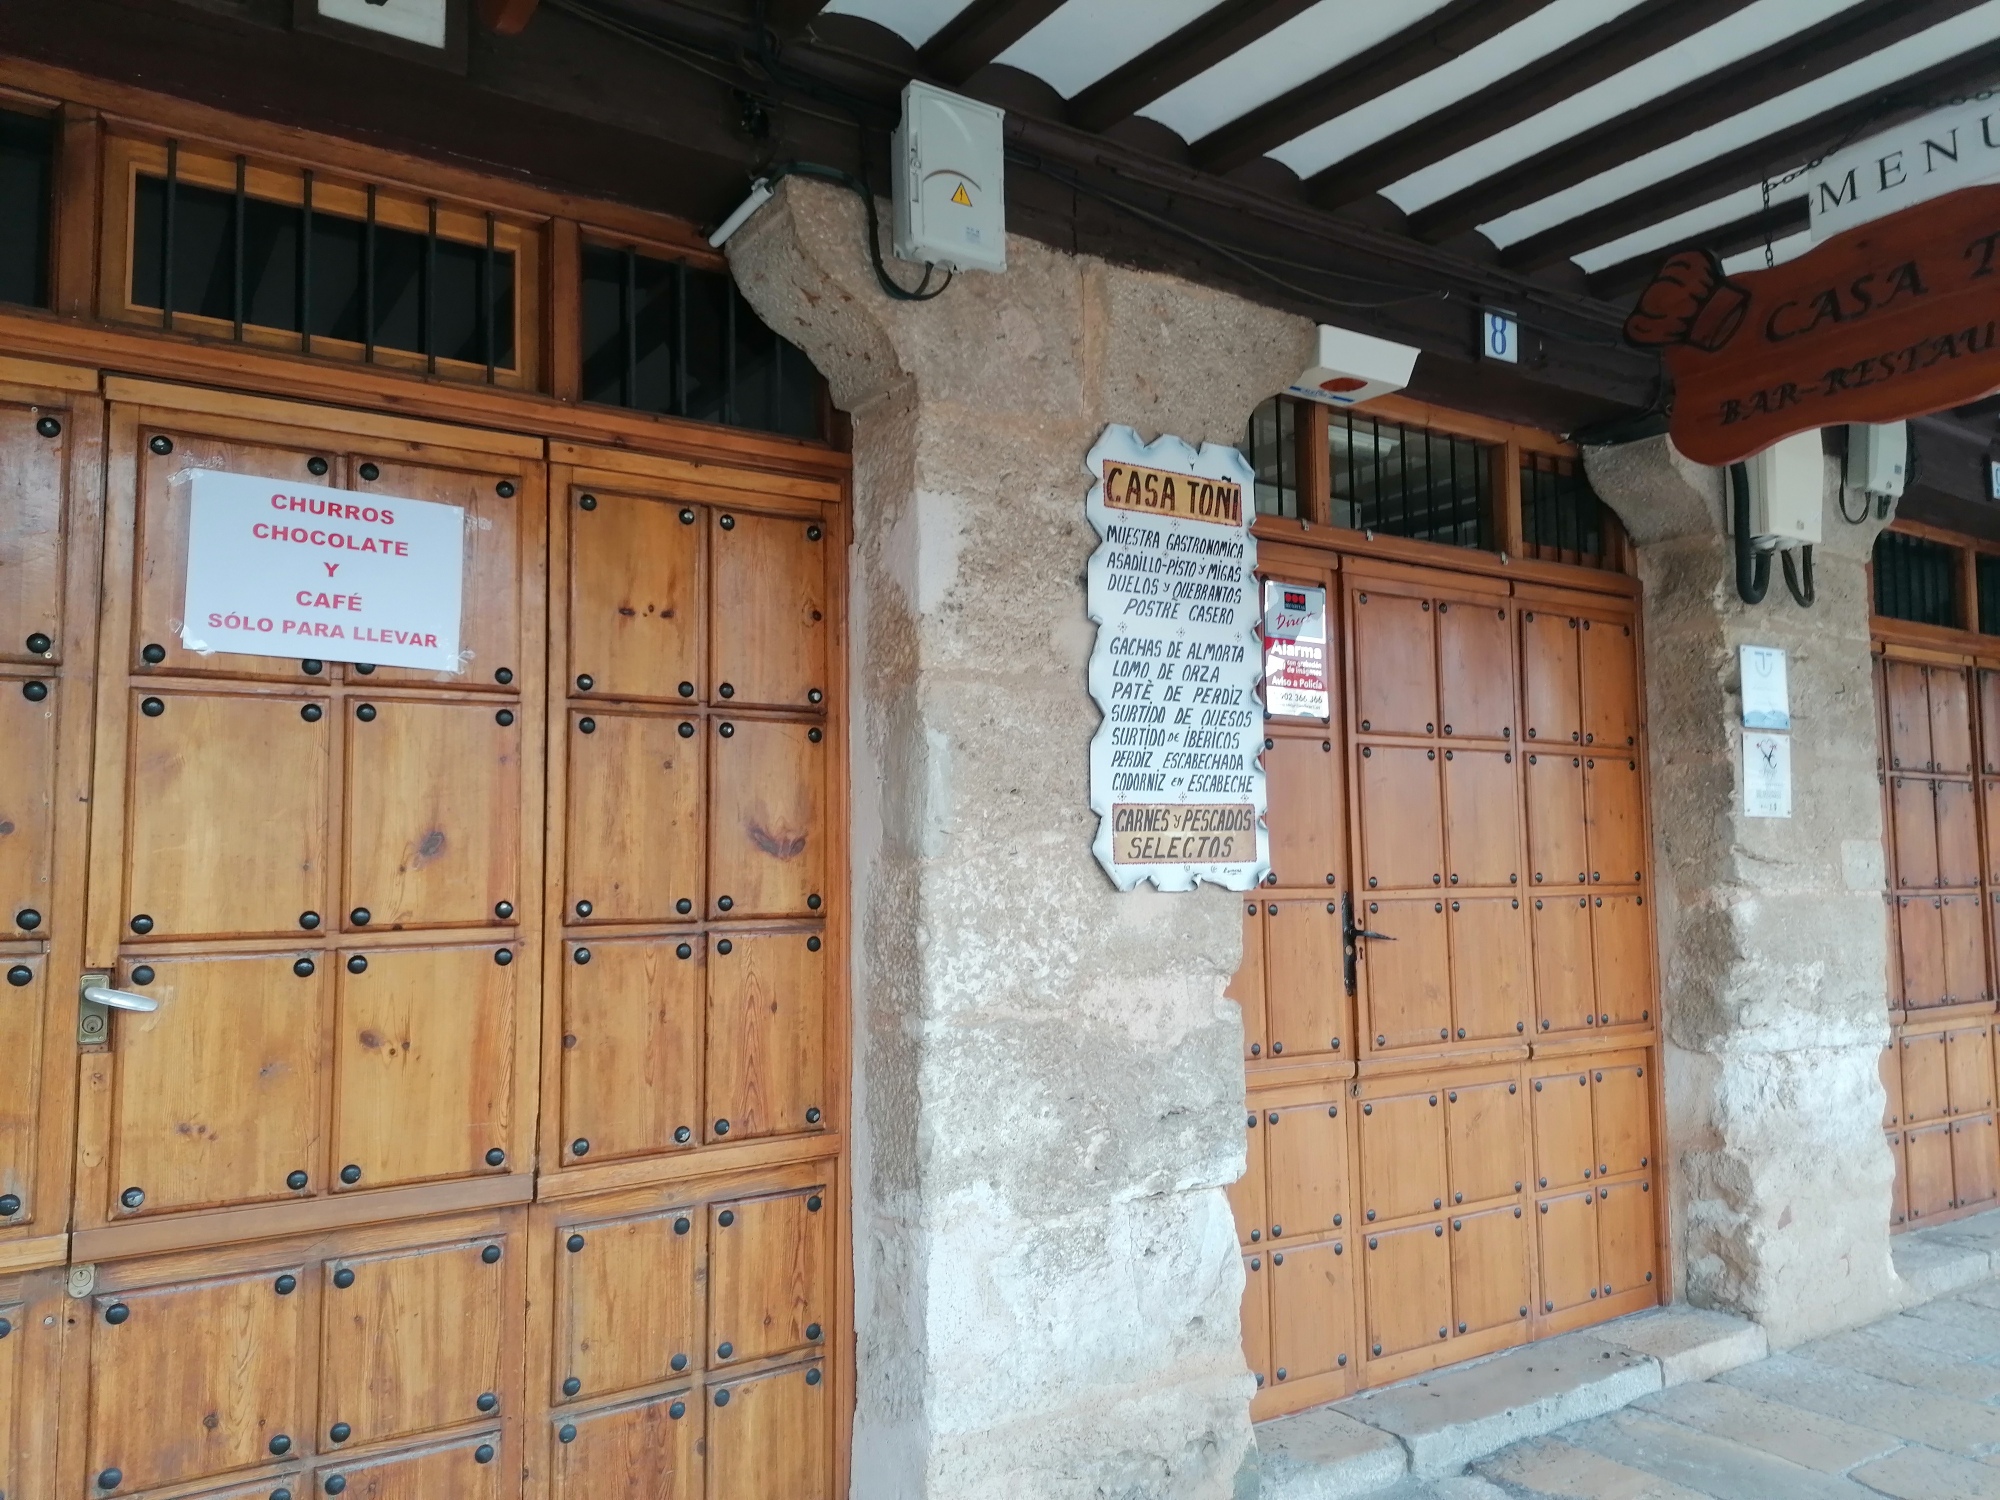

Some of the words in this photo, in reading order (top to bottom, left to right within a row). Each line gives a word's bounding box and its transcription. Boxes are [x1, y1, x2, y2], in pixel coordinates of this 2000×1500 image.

[1765, 259, 1930, 343] CASA
[1491, 313, 1507, 355] 8
[1106, 468, 1175, 511] CASA
[1187, 475, 1239, 521] TOÑI
[271, 494, 395, 525] CHURROS
[252, 523, 409, 556] CHOCOLATE
[1107, 525, 1160, 549] MUESTRA
[1166, 533, 1244, 559] GASTRONOMICA
[323, 562, 340, 578] Y
[1206, 560, 1242, 583] MIGAS
[295, 590, 363, 612] CAFÉ
[1107, 574, 1159, 595] DUELOS
[1172, 581, 1242, 604] QUEBRANTOS
[1123, 598, 1180, 619] POSTRE
[1188, 604, 1234, 625] CASERO
[207, 611, 274, 633] SÓLO
[281, 619, 345, 639] PARA
[353, 626, 438, 648] LLEVAR
[1109, 636, 1163, 658] GACHAS
[1166, 641, 1183, 659] DE
[1186, 642, 1245, 663] ALMORTA
[1271, 640, 1323, 660] Alarma
[1112, 660, 1149, 678] LOMO
[1157, 663, 1175, 681] DE
[1182, 665, 1220, 683] ORZA
[1271, 675, 1292, 687] Aviso
[1292, 680, 1298, 688] a
[1299, 678, 1323, 690] Policía
[1163, 685, 1183, 702] DE
[1192, 684, 1243, 706] PERDIZ
[1111, 701, 1166, 724] SURTIDO
[1173, 707, 1193, 725] DE
[1201, 709, 1252, 728] QUESOS
[1111, 724, 1166, 747] SURTIDO
[1111, 747, 1153, 768] PERDIZ
[1162, 752, 1244, 771] ESCABECHADA
[1112, 769, 1166, 792] CODORNIZ
[1187, 774, 1254, 793] ESCABECHE
[1115, 808, 1171, 832] CARNES
[1181, 808, 1252, 832] PESCADOS
[1127, 836, 1234, 859] SELECTOS
